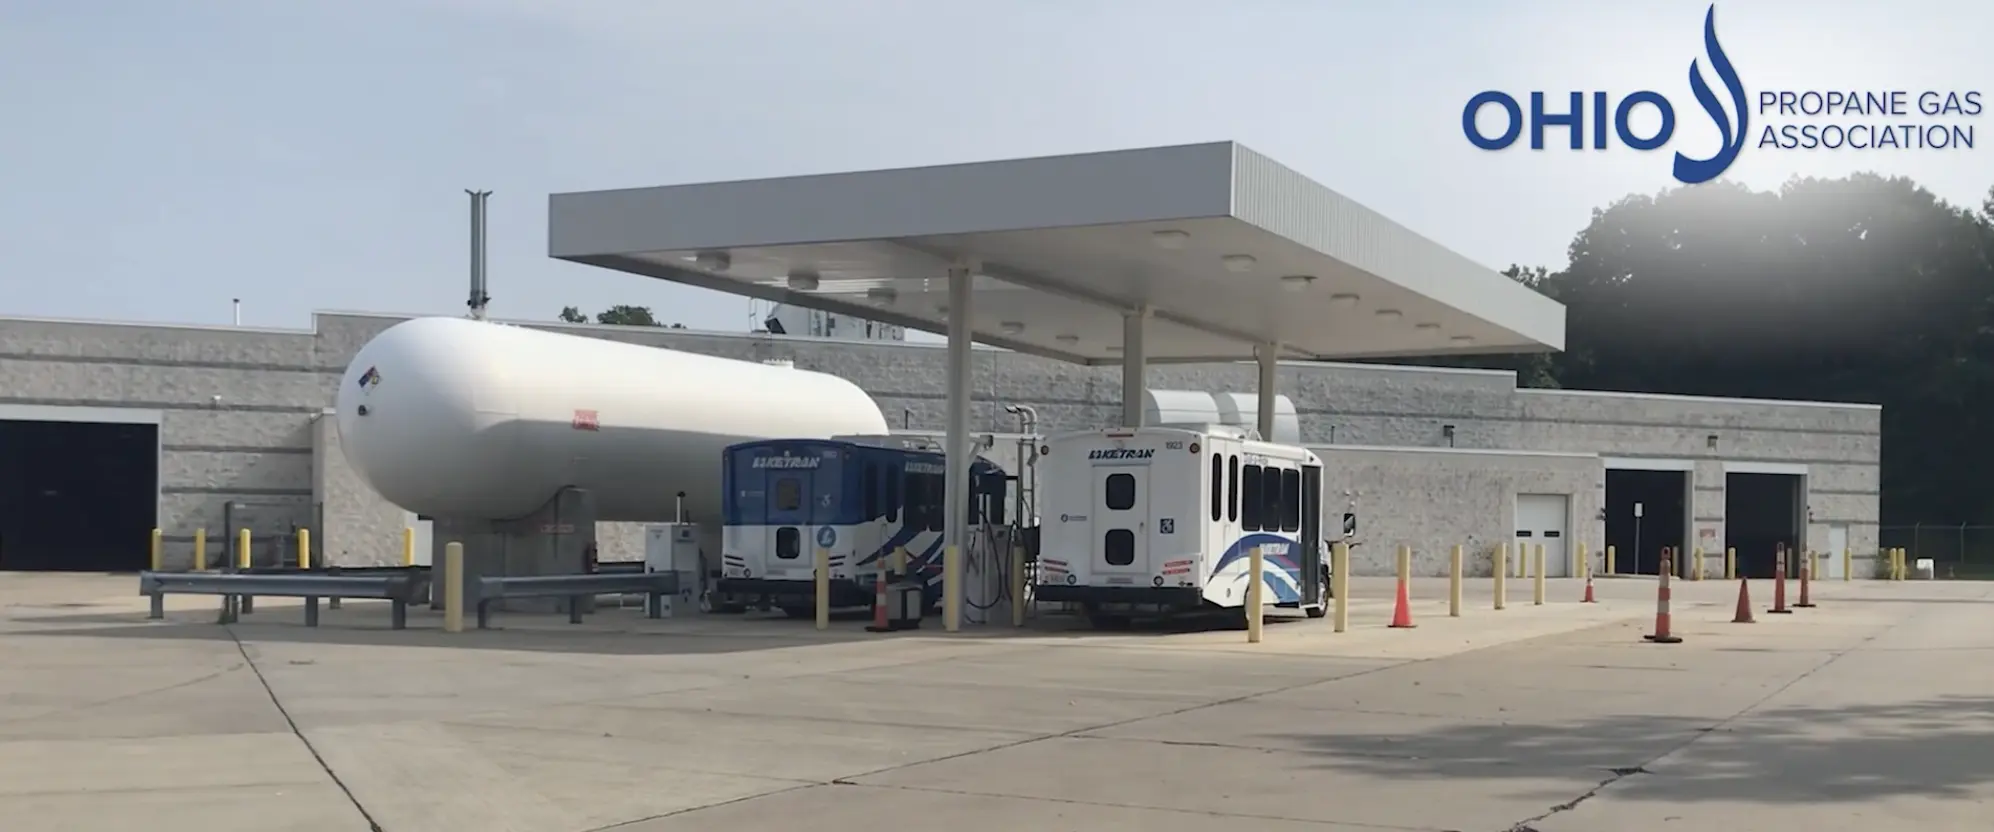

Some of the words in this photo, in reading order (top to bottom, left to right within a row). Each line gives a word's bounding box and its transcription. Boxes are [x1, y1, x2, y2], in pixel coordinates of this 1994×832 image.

[1165, 440, 1183, 450] 1923
[1088, 449, 1155, 460] LAKETRAN
[752, 456, 820, 468] LAKETRAN
